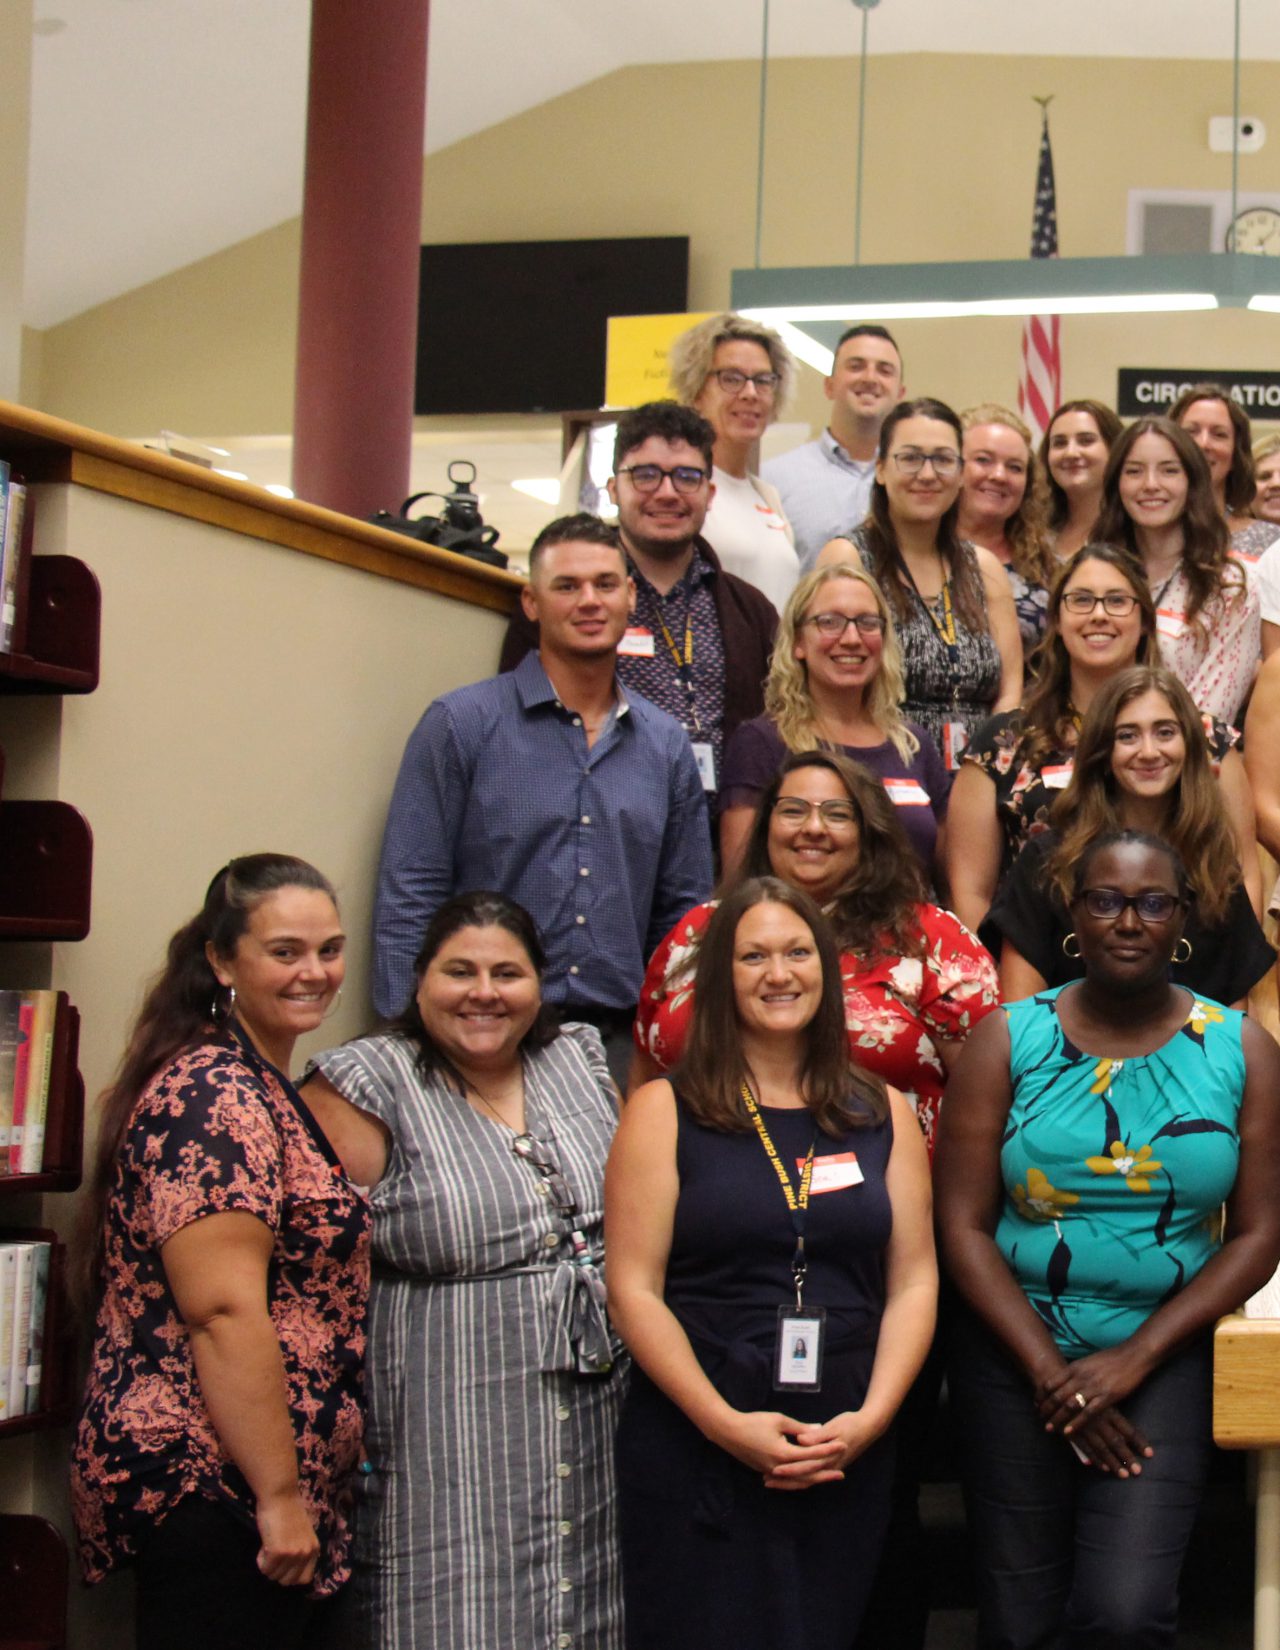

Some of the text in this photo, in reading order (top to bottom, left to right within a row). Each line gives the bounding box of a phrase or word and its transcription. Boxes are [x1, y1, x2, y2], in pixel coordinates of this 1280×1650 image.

[752, 1114, 777, 1158] CENTRAL
[770, 1157, 789, 1185] BUSH
[798, 1162, 814, 1209] DISTRICT
[782, 1184, 798, 1211] PINE
